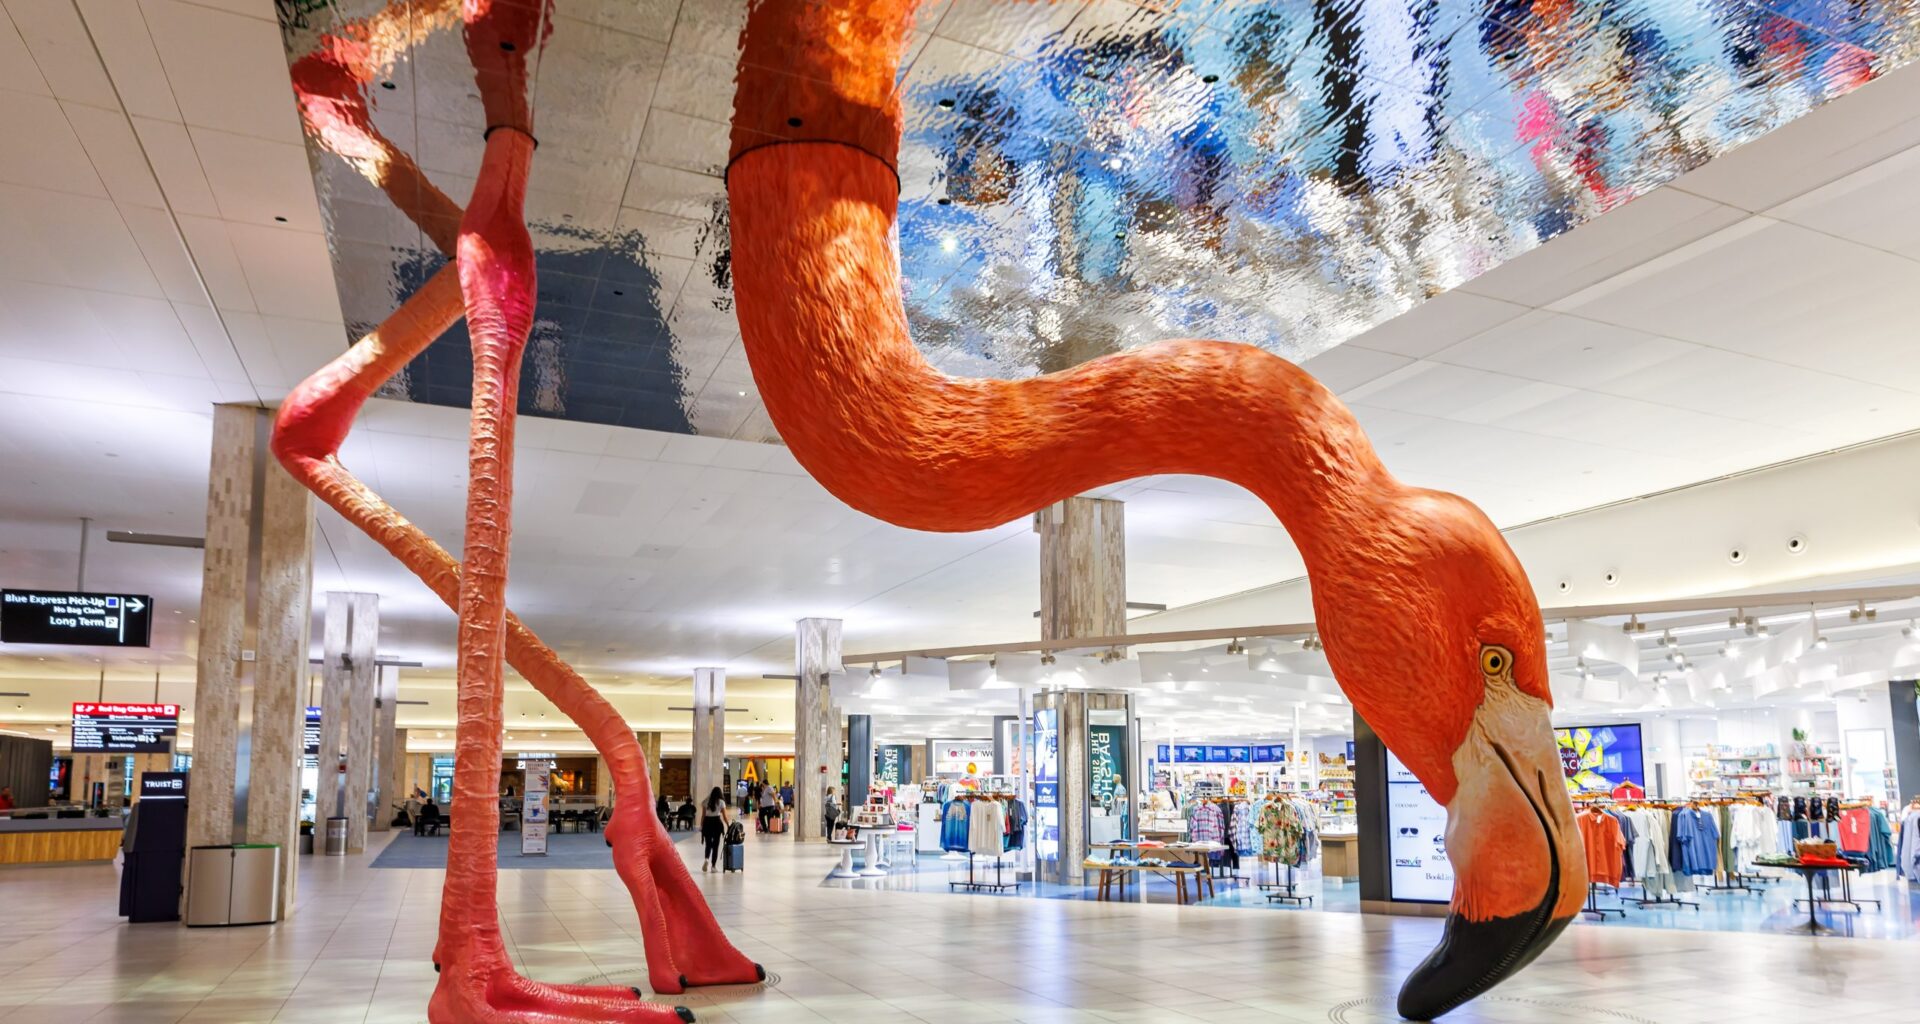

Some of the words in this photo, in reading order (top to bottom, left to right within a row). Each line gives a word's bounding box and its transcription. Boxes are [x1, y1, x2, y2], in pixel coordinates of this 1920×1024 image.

[5, 594, 27, 603] Blue
[29, 595, 67, 605] Express
[68, 596, 105, 606] Pick-Up
[67, 606, 82, 615] Bag
[83, 606, 105, 614] Claim
[49, 616, 77, 627] Long
[78, 617, 104, 627] Term
